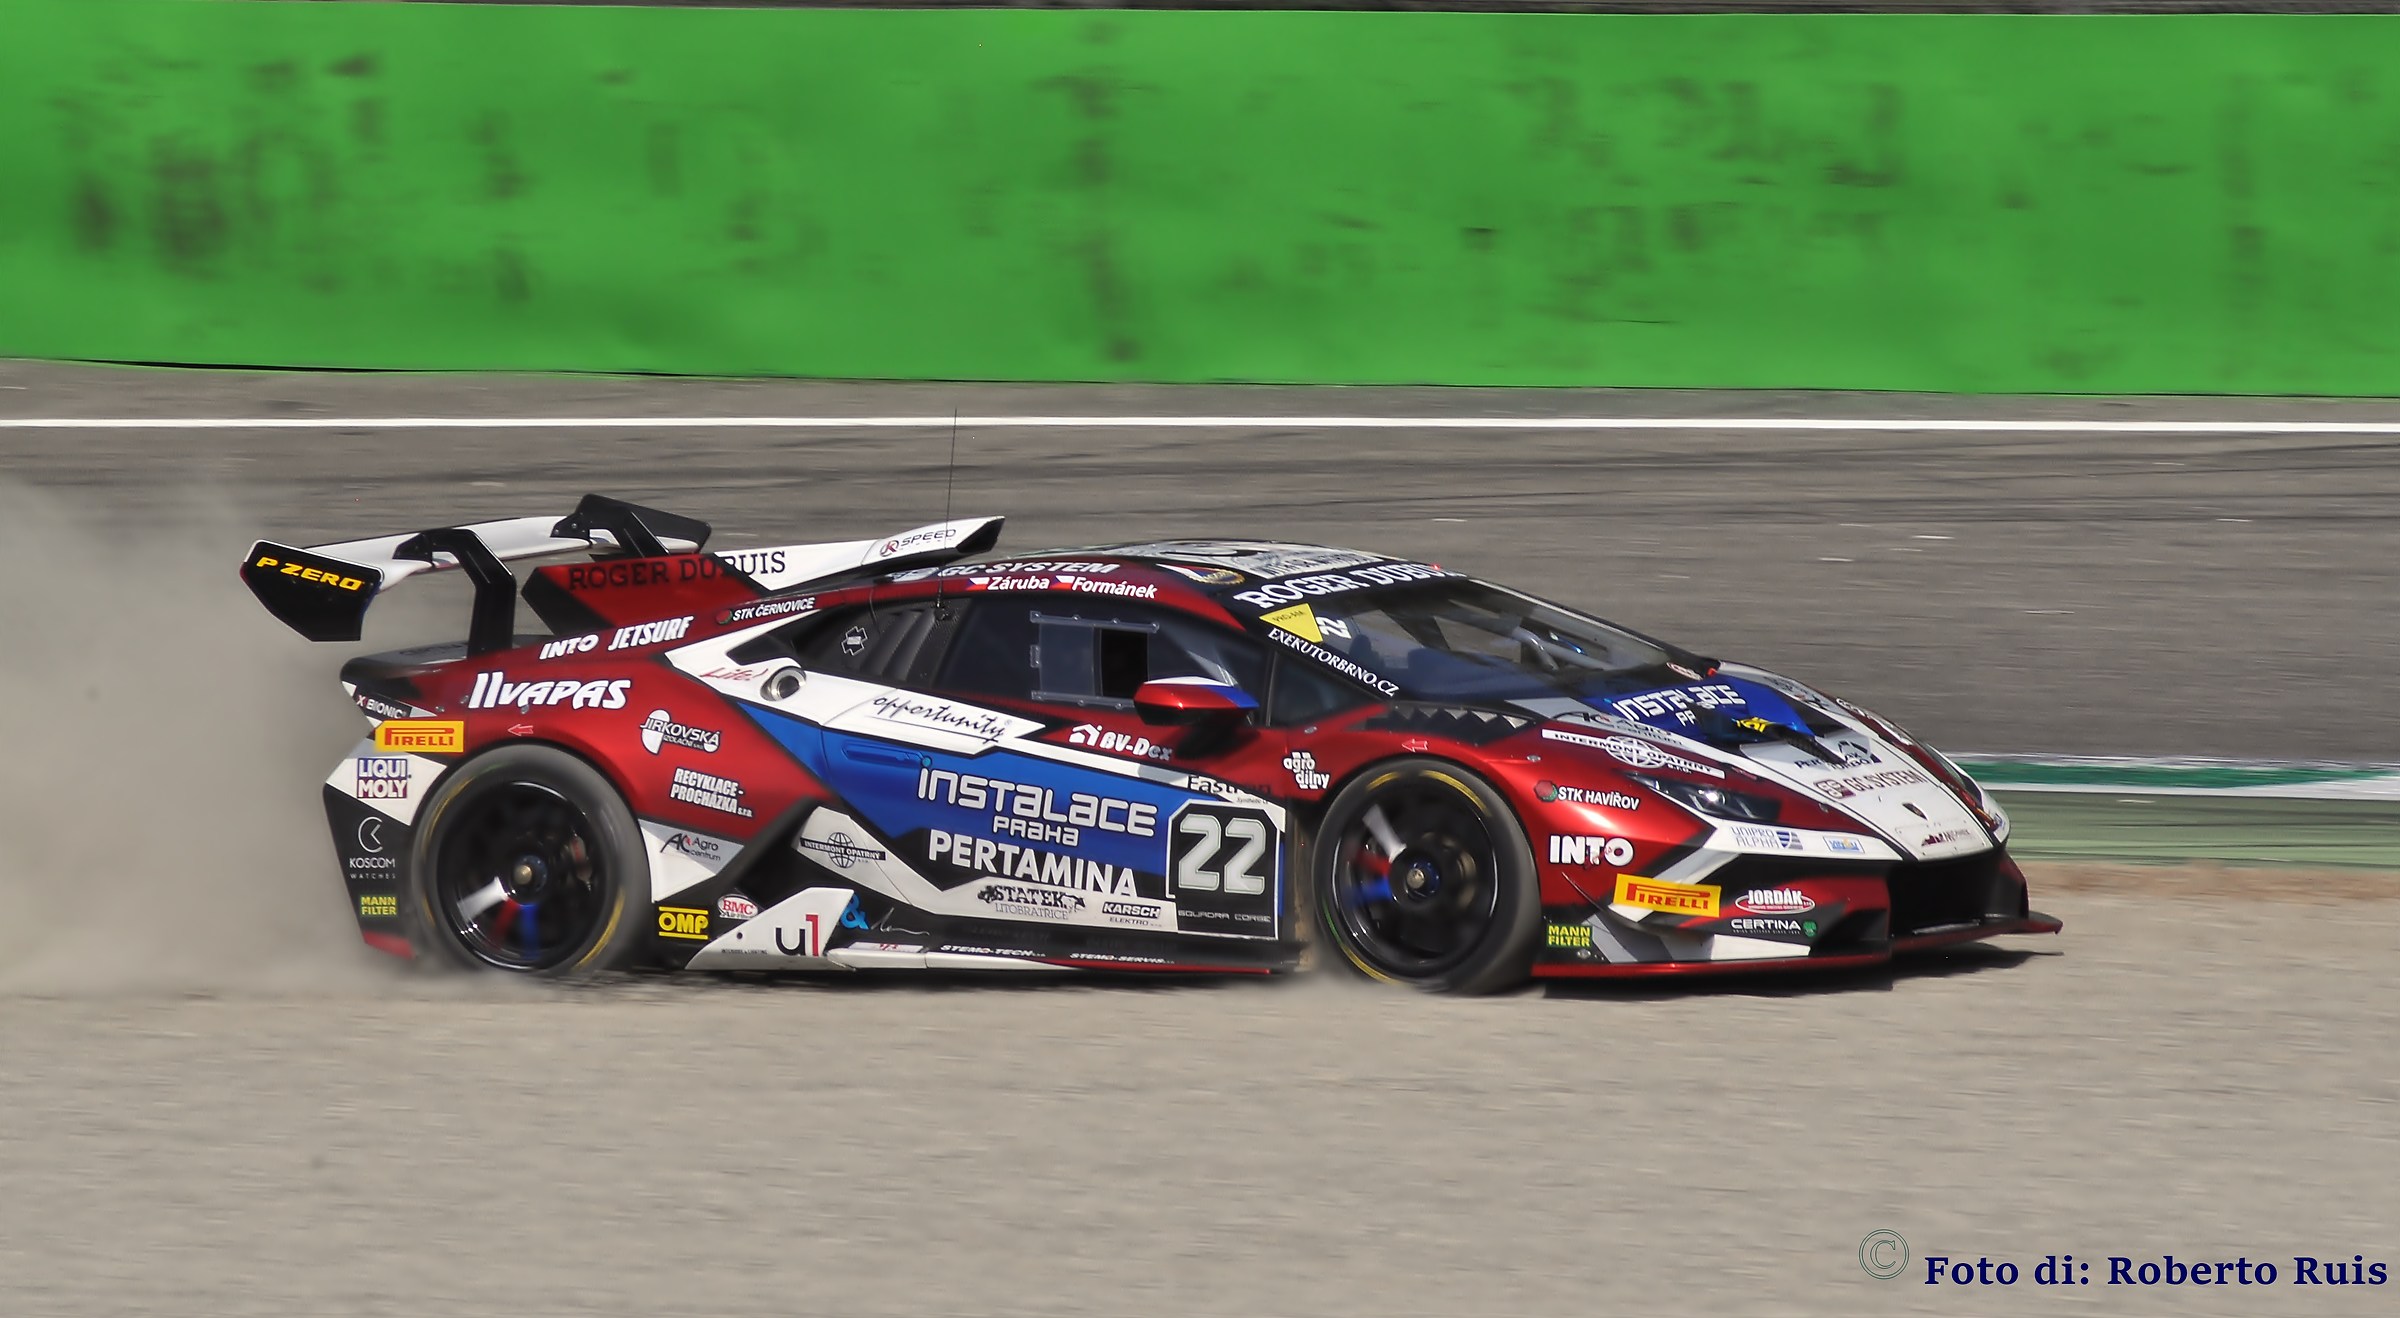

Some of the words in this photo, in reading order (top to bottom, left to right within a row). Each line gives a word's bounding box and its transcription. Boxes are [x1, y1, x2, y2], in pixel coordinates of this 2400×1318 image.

[901, 529, 956, 546] SPEED
[256, 556, 277, 569] P
[280, 563, 364, 591] ZERO
[569, 561, 669, 590] ROGER
[985, 562, 1121, 574] SYSTEM
[987, 575, 1051, 591] Záruba
[1071, 576, 1158, 600] Formánek
[1234, 574, 1370, 609] ROGER
[732, 607, 753, 621] STK
[755, 597, 815, 616] ČERNOVICE
[539, 634, 600, 660] INTO
[607, 615, 695, 651] JETSURF
[1267, 627, 1400, 698] EXEKUTORBRNO.CZ
[356, 694, 368, 706] X
[366, 699, 403, 719] BIONIC
[873, 695, 1007, 744] opportunity
[384, 727, 455, 746] PIRELLI
[640, 717, 721, 746] JIRKOVSKÁ
[1099, 731, 1173, 761] BV-Dex
[1553, 733, 1641, 754] INTERMONT
[358, 758, 407, 778] LIQUI
[358, 779, 408, 798] MOLY
[674, 767, 739, 797] RECYKLACE
[1863, 769, 1927, 790] SYSTEM
[670, 784, 738, 814] PROCHÁZKA
[1558, 786, 1584, 802] STK
[1585, 787, 1640, 811] HAVÍŘOV
[1731, 826, 1775, 837] UNIPRO
[691, 837, 719, 852] Agro
[804, 840, 845, 854] INTERMONT
[1550, 834, 1634, 867] INTO
[1736, 836, 1780, 849] ALPHA
[349, 857, 396, 869] KOSCOM
[929, 828, 1138, 899] PERTAMINA
[1178, 813, 1267, 895] 22
[361, 896, 397, 906] MANN
[992, 884, 1069, 909] STATEK
[1626, 882, 1711, 910] PIRELLI
[1748, 887, 1803, 906] JORDÁK
[361, 906, 397, 916] FILTER
[723, 899, 754, 915] BMC
[995, 902, 1069, 920] LITOBRATRICE
[1103, 902, 1160, 918] KARSCH
[1177, 909, 1230, 920] SQUADRA
[1234, 913, 1271, 923] CORSE
[658, 911, 709, 934] OMP
[1109, 916, 1149, 926] ELEKTRO
[1548, 925, 1592, 936] MANN
[1731, 918, 1802, 931] CERTINA
[1547, 936, 1591, 947] FILTER
